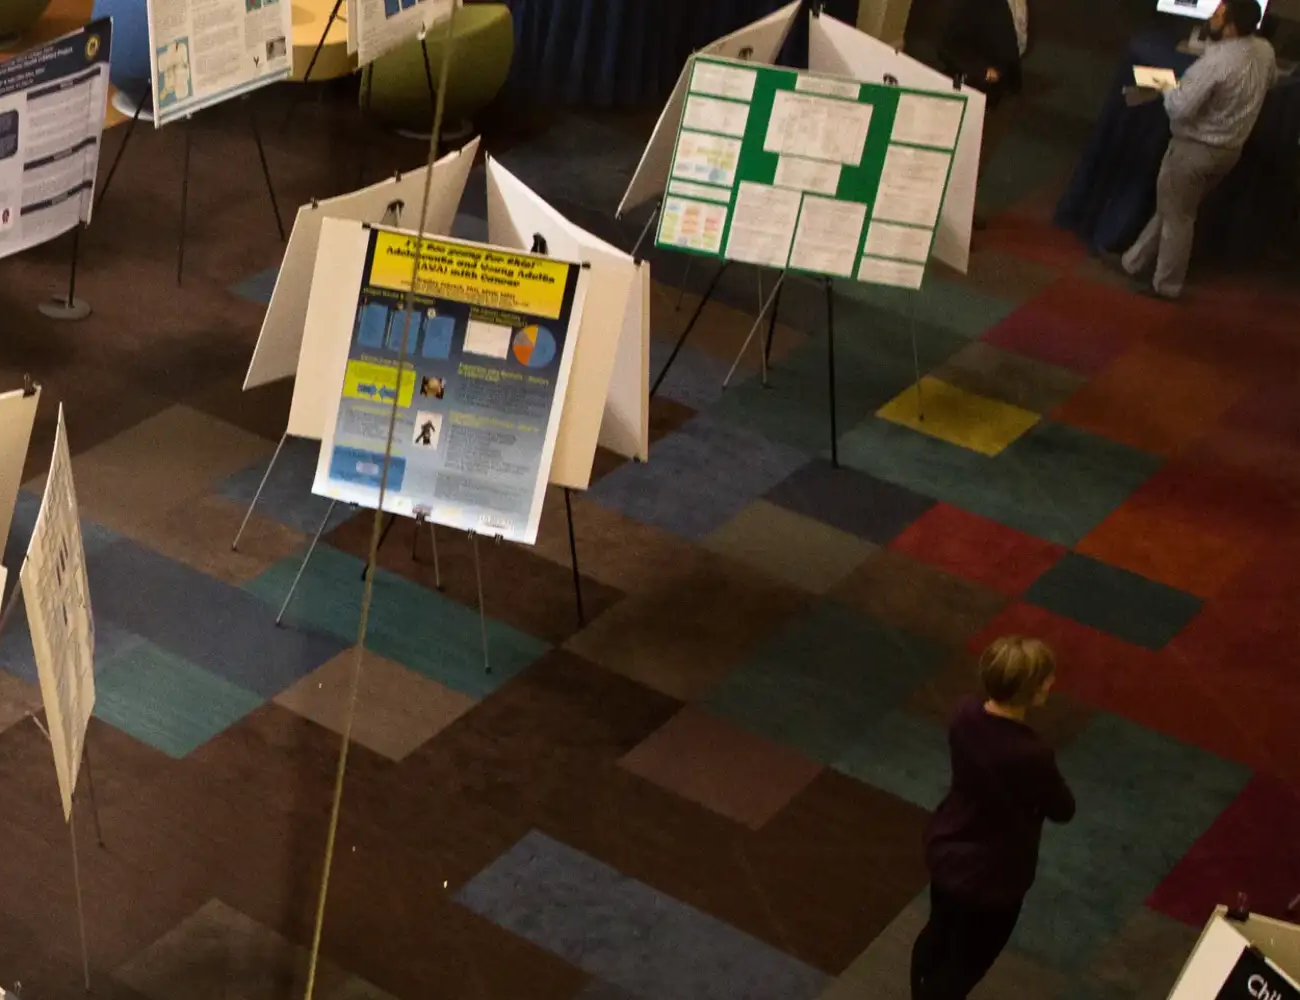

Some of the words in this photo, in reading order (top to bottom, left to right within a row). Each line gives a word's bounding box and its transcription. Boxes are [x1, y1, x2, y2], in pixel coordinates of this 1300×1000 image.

[427, 243, 446, 253] too
[450, 267, 478, 280] with
[480, 274, 520, 288] Cancer
[456, 260, 478, 269] and
[480, 264, 514, 278] Young
[518, 270, 556, 284] Adults
